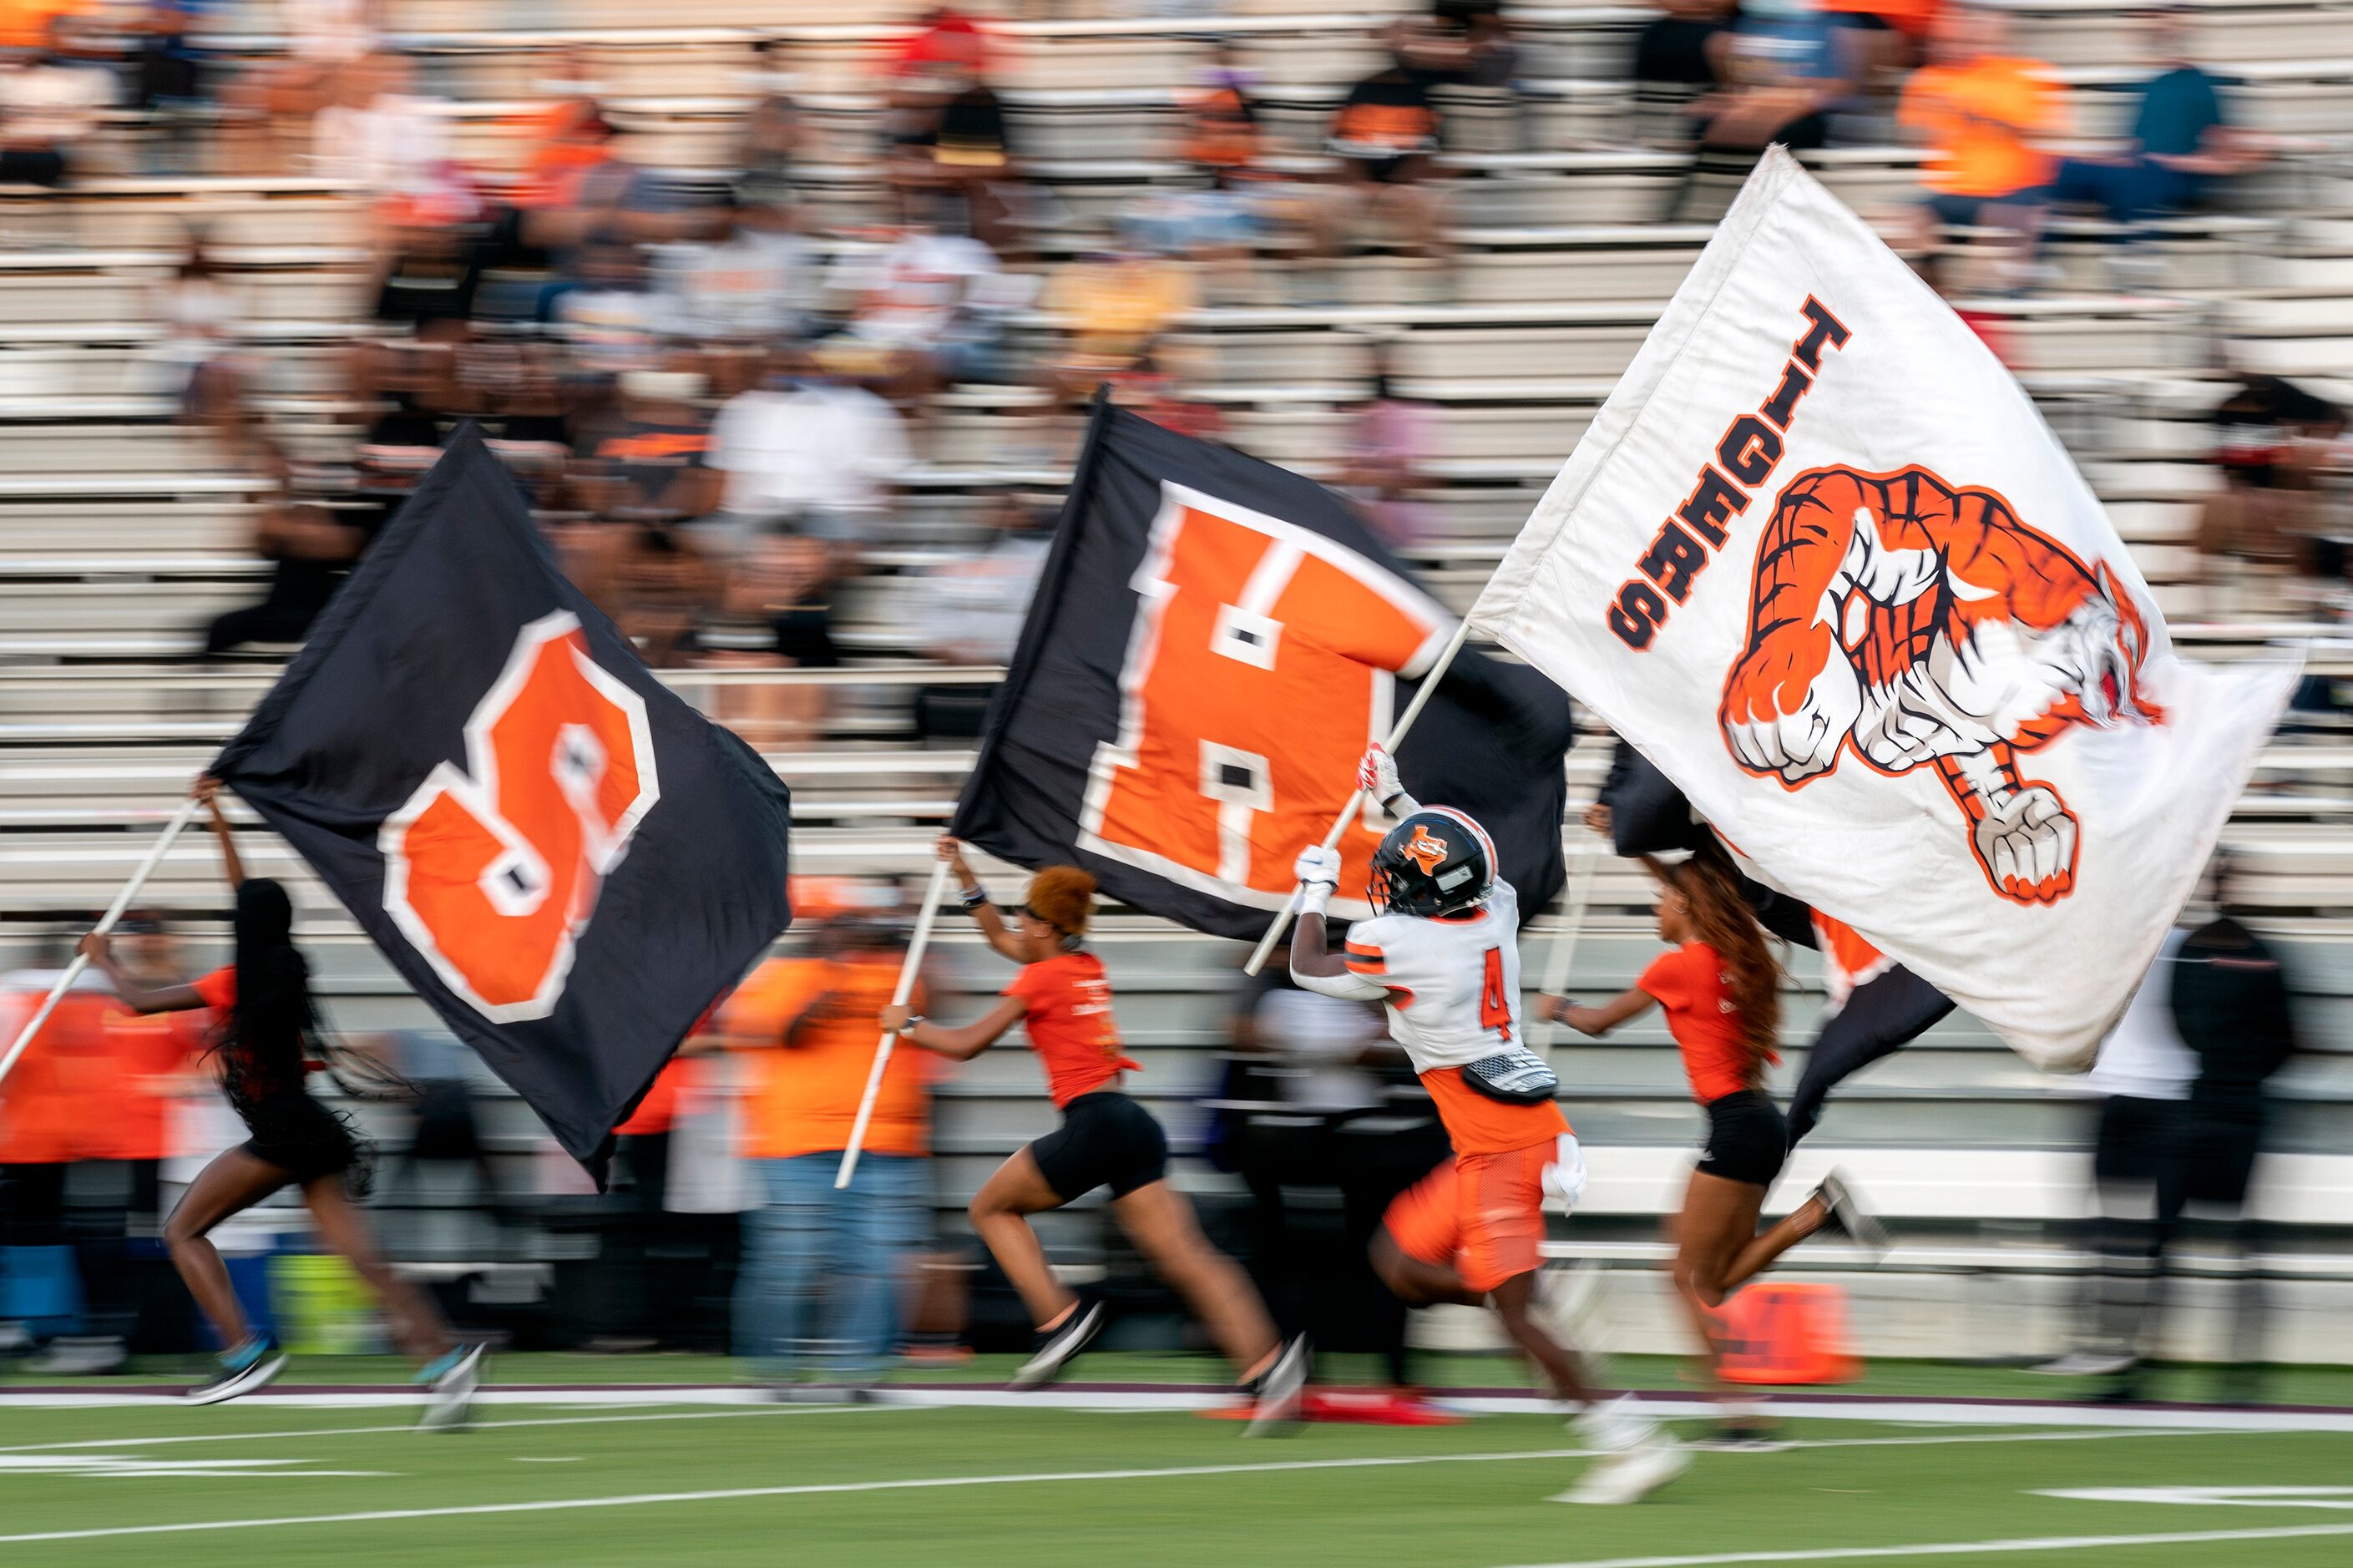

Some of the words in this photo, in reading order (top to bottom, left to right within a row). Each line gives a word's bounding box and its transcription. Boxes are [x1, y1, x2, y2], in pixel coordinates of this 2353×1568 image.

[1606, 293, 1853, 654] TIGERS
[377, 606, 661, 1025] S
[1480, 946, 1512, 1042] 4
